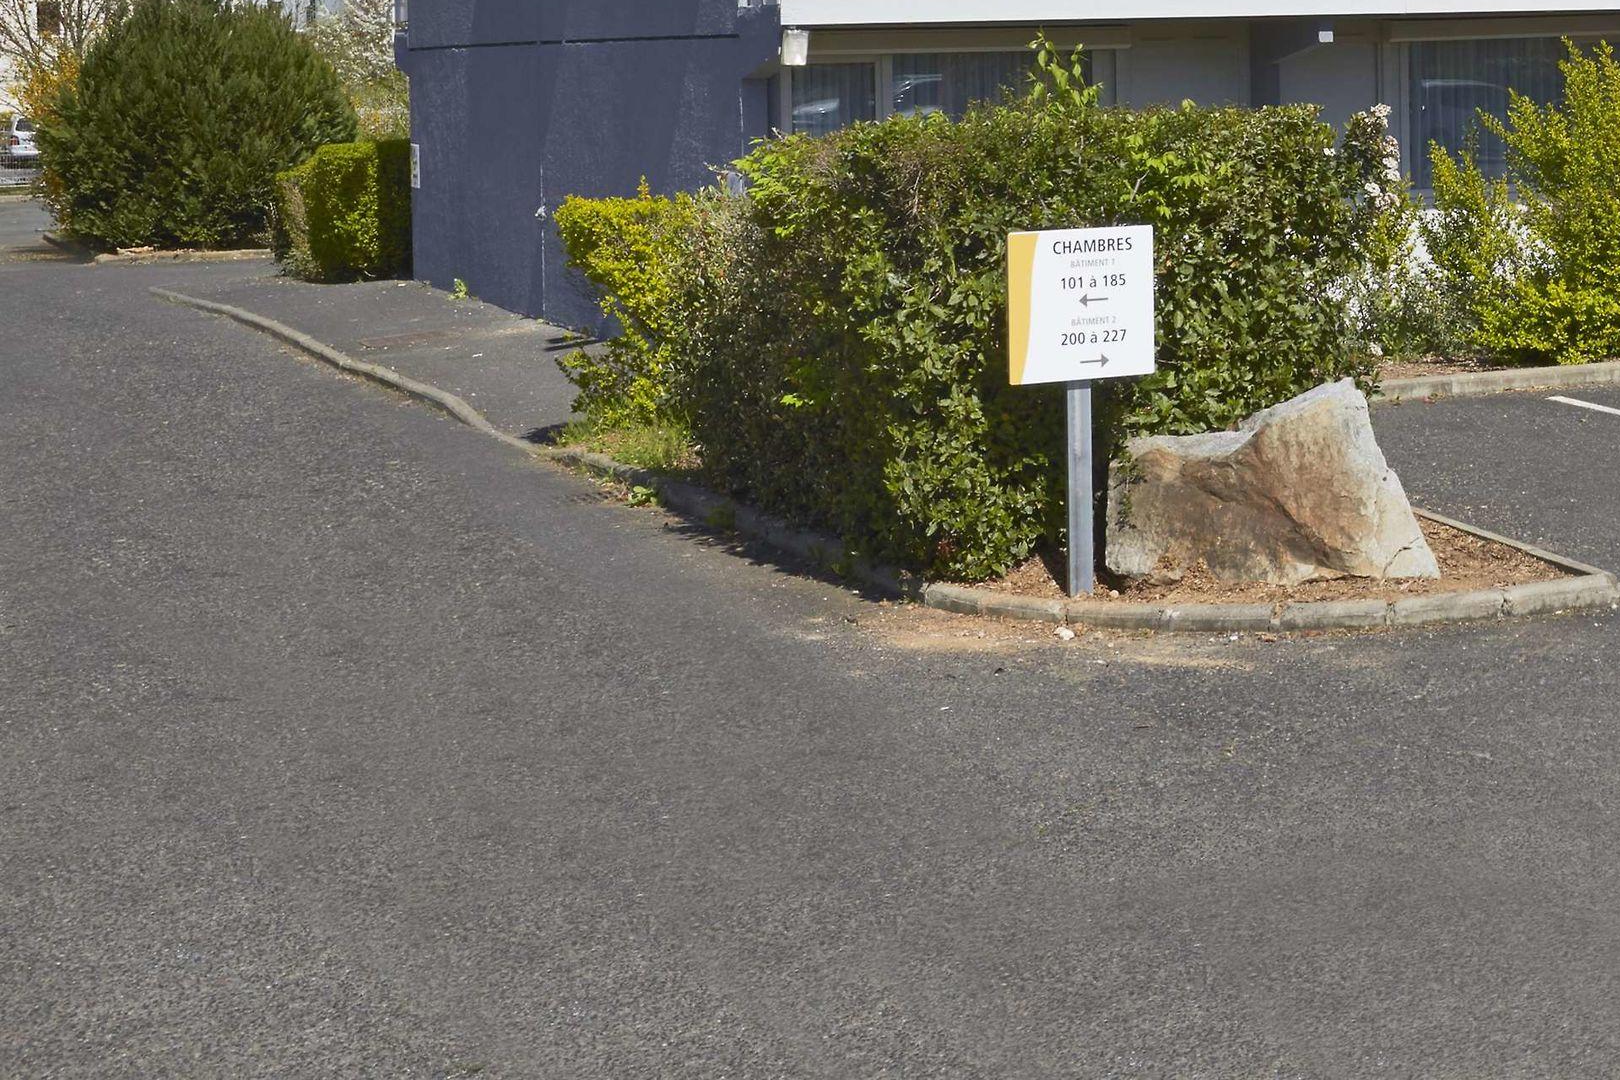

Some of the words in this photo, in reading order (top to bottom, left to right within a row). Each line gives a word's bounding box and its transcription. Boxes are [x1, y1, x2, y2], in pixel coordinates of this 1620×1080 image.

[1052, 237, 1133, 255] CHAMBRES
[1060, 277, 1084, 290] 101
[1089, 275, 1097, 288] à
[1102, 273, 1126, 287] 185
[1111, 315, 1117, 324] 2
[1060, 332, 1086, 346] 200
[1090, 332, 1098, 344] à
[1103, 329, 1127, 343] 227
